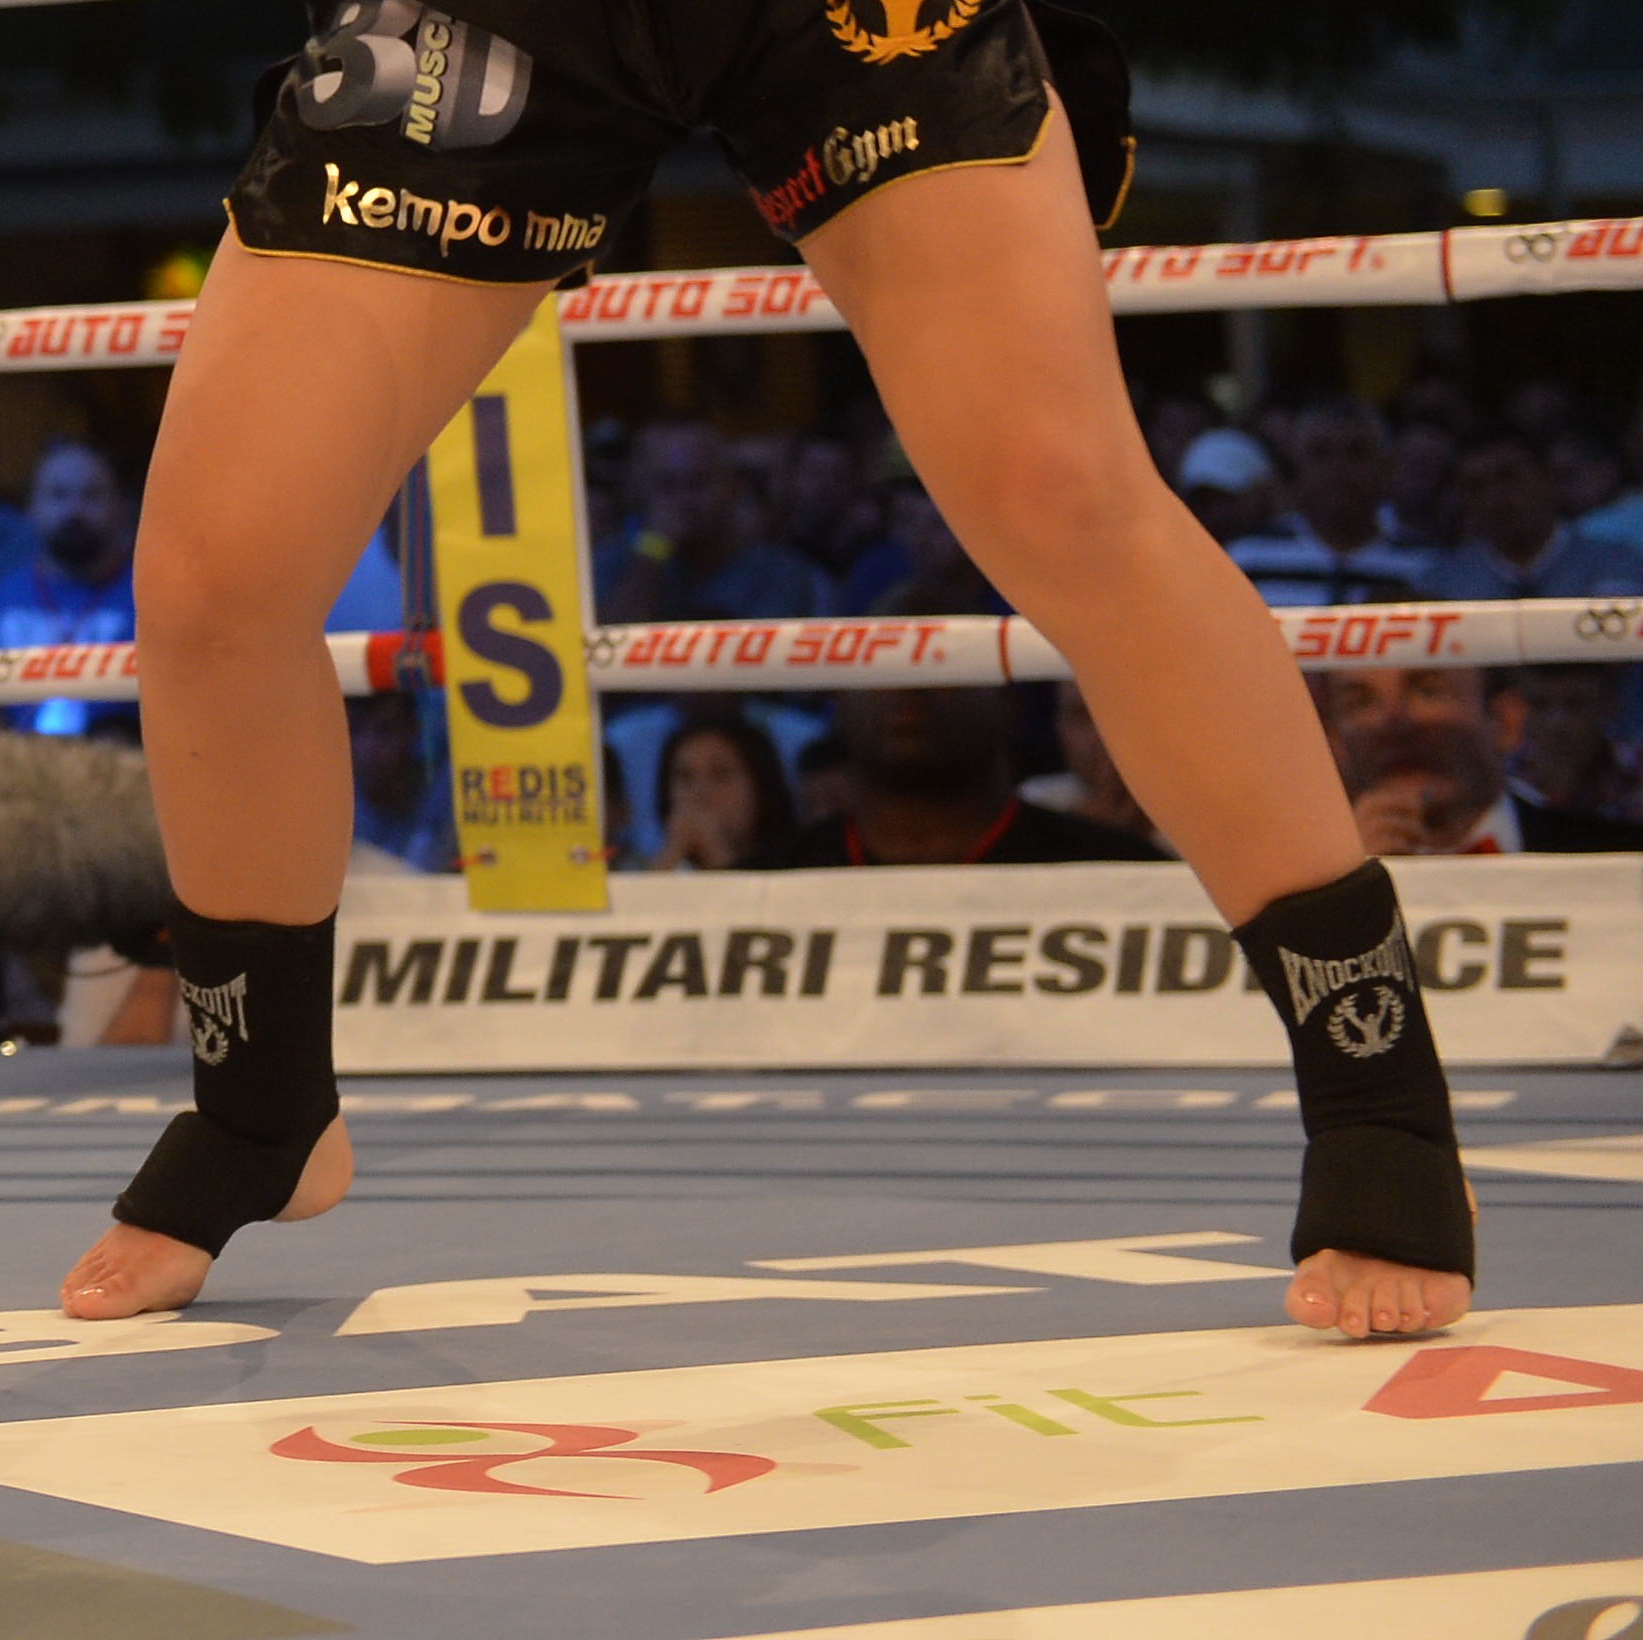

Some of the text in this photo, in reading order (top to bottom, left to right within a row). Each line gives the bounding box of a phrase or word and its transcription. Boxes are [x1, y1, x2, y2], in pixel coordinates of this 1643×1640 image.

[405, 15, 453, 145] MUSC
[323, 164, 606, 258] kempo mma
[722, 271, 830, 317] SOF
[1104, 245, 1198, 287] UTO
[456, 394, 565, 729] IS
[462, 764, 587, 800] REDIS
[340, 916, 1572, 1005] MILITARI RESIDCE
[175, 970, 249, 1042] CKOUT
